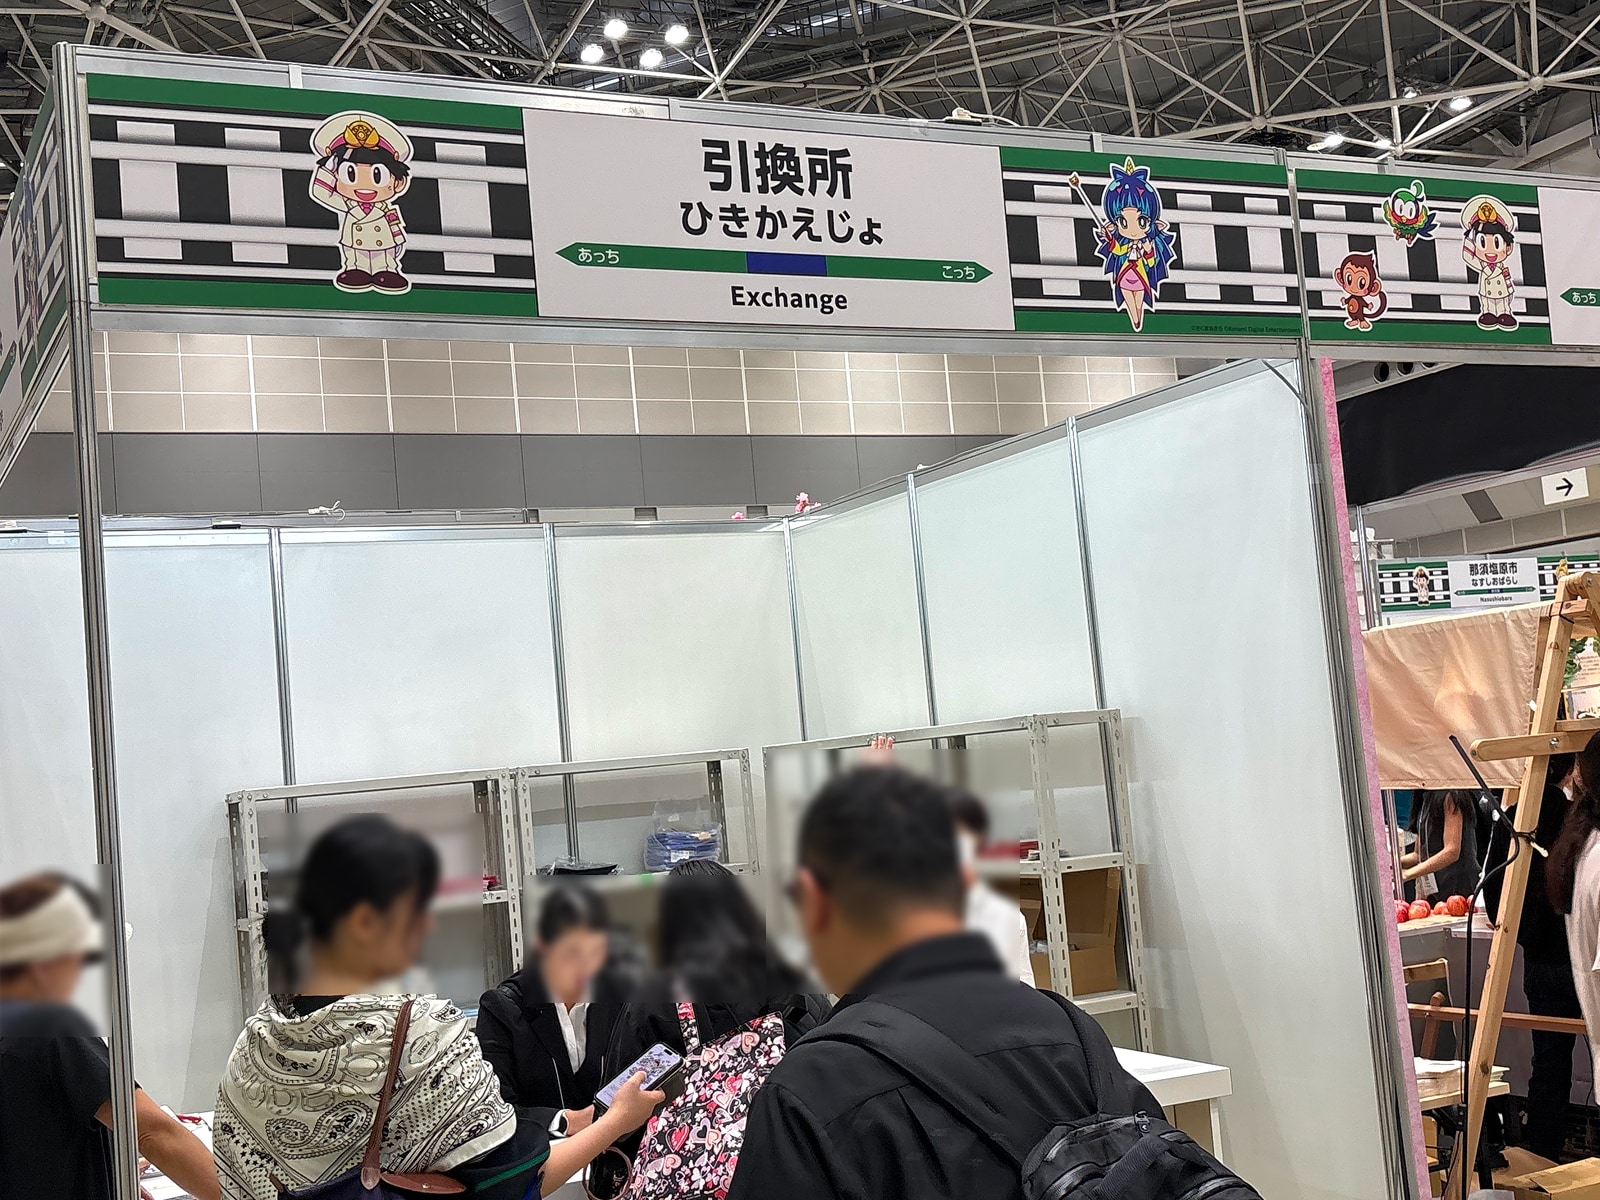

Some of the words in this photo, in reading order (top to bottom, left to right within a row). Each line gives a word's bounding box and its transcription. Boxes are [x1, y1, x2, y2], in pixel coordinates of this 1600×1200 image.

[701, 138, 853, 200] 引換所
[680, 201, 883, 245] ひきかえじょ
[578, 247, 620, 264] あっち
[942, 265, 976, 280] こっち
[731, 285, 848, 315] Exchange
[1572, 291, 1597, 304] あっち
[1469, 562, 1518, 576] 那須塩原市
[1471, 576, 1518, 587] なすしおばらし
